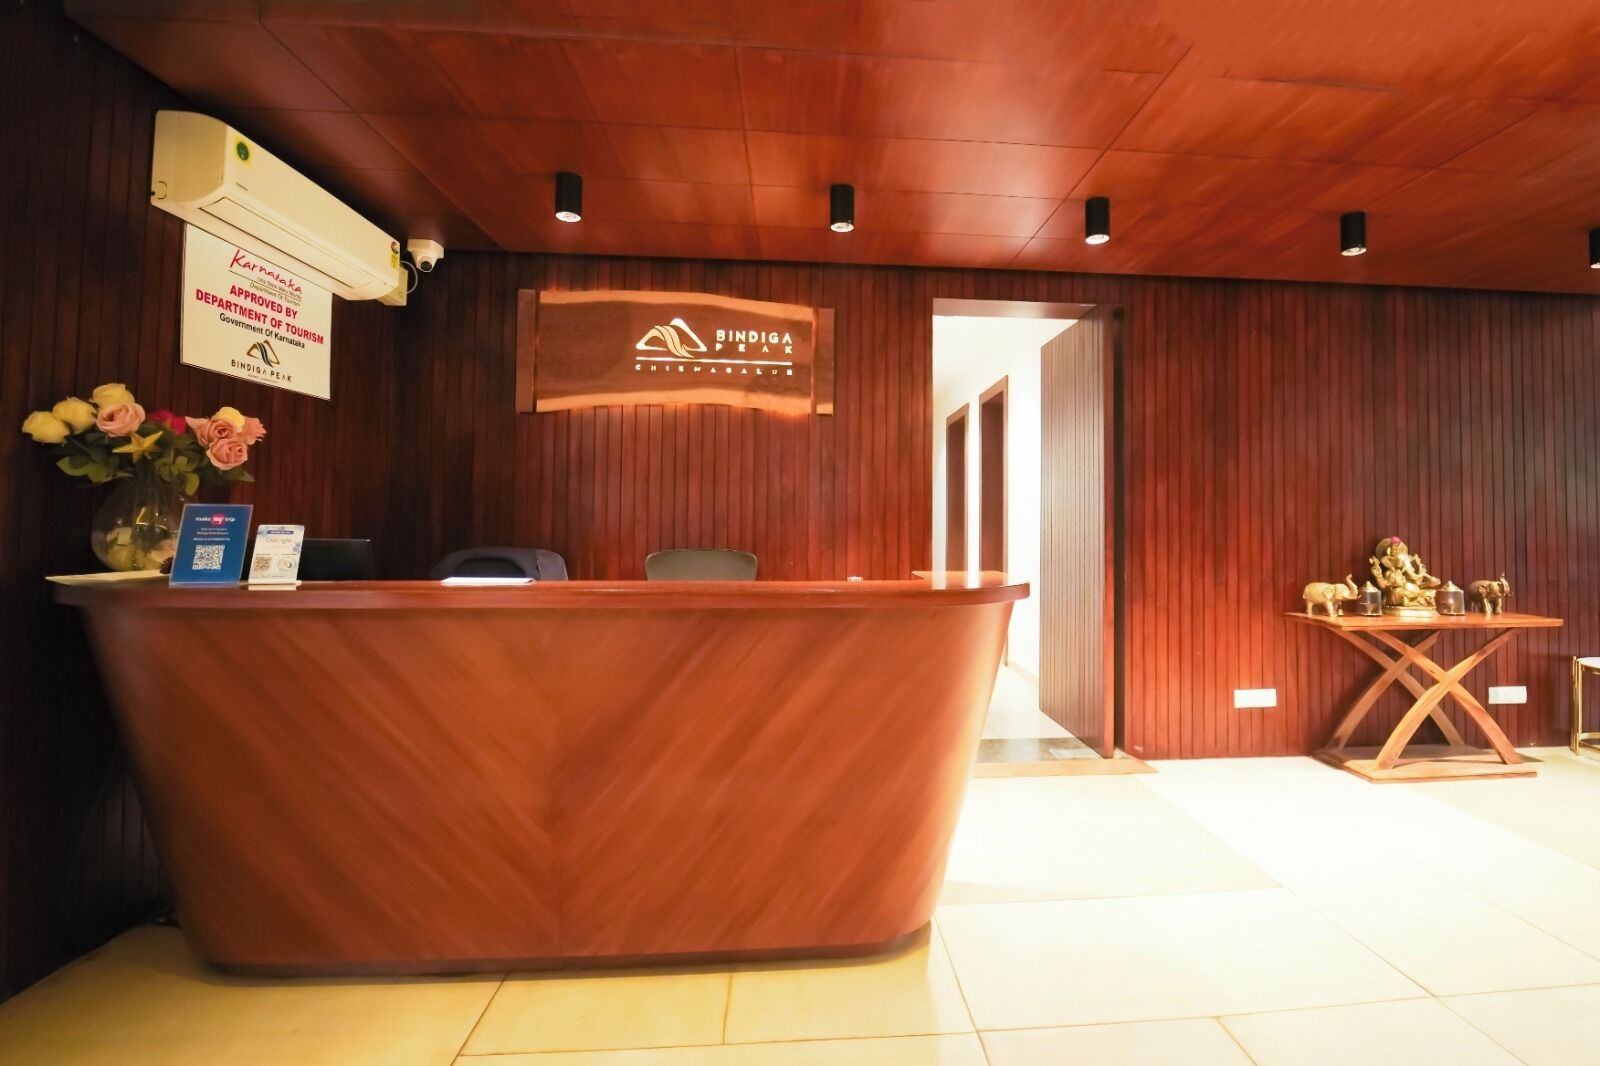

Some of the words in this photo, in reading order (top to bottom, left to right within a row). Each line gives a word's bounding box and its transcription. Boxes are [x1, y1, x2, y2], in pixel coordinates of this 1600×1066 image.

[229, 248, 302, 293] Karnataka
[195, 288, 268, 324] DEPARTMENT
[270, 317, 283, 329] OF
[285, 322, 325, 345] TOURISM
[230, 285, 283, 314] APPROVED
[285, 306, 298, 320] BY
[219, 312, 264, 335] Government
[265, 328, 273, 337] Of
[274, 333, 306, 349] Karnataka
[715, 342, 793, 354] PEAK
[716, 329, 793, 344] BINDIGA
[231, 359, 268, 375] BINDIGA
[270, 370, 293, 383] PEAK
